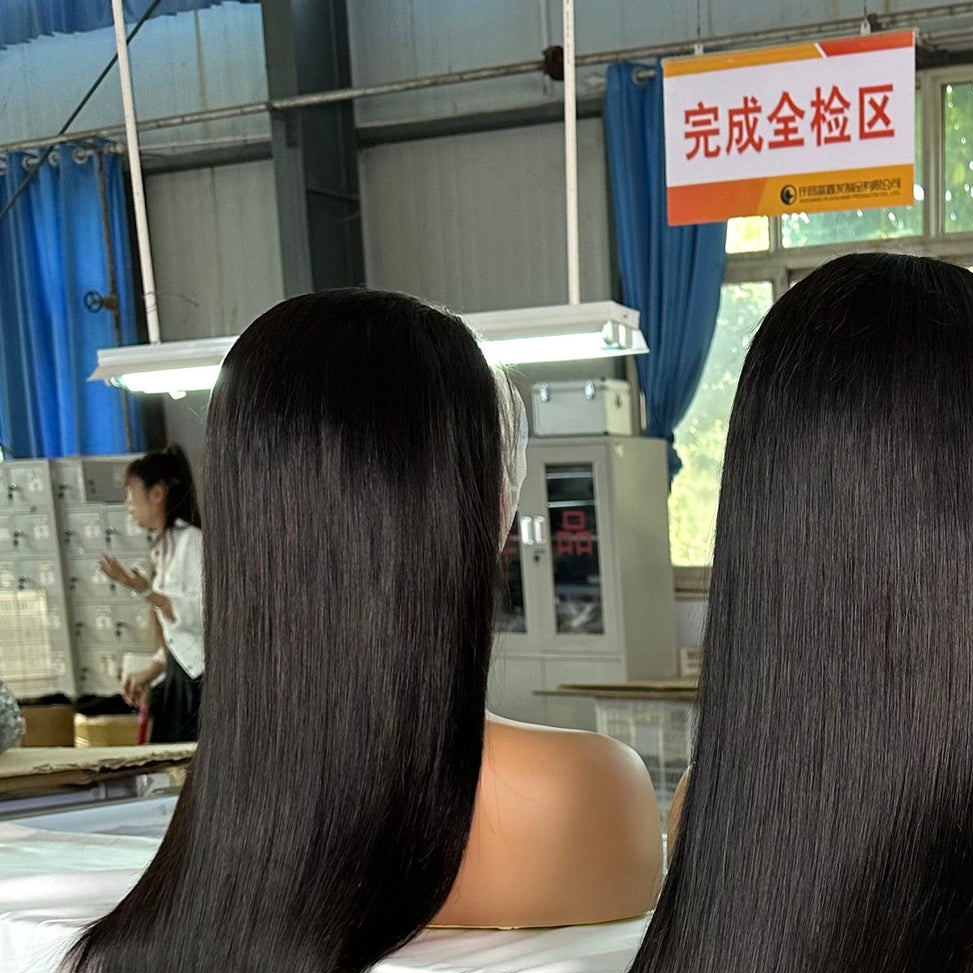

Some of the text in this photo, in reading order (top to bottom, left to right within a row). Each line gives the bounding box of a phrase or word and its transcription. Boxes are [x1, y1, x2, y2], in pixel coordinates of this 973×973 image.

[683, 83, 895, 161] 完成全检区
